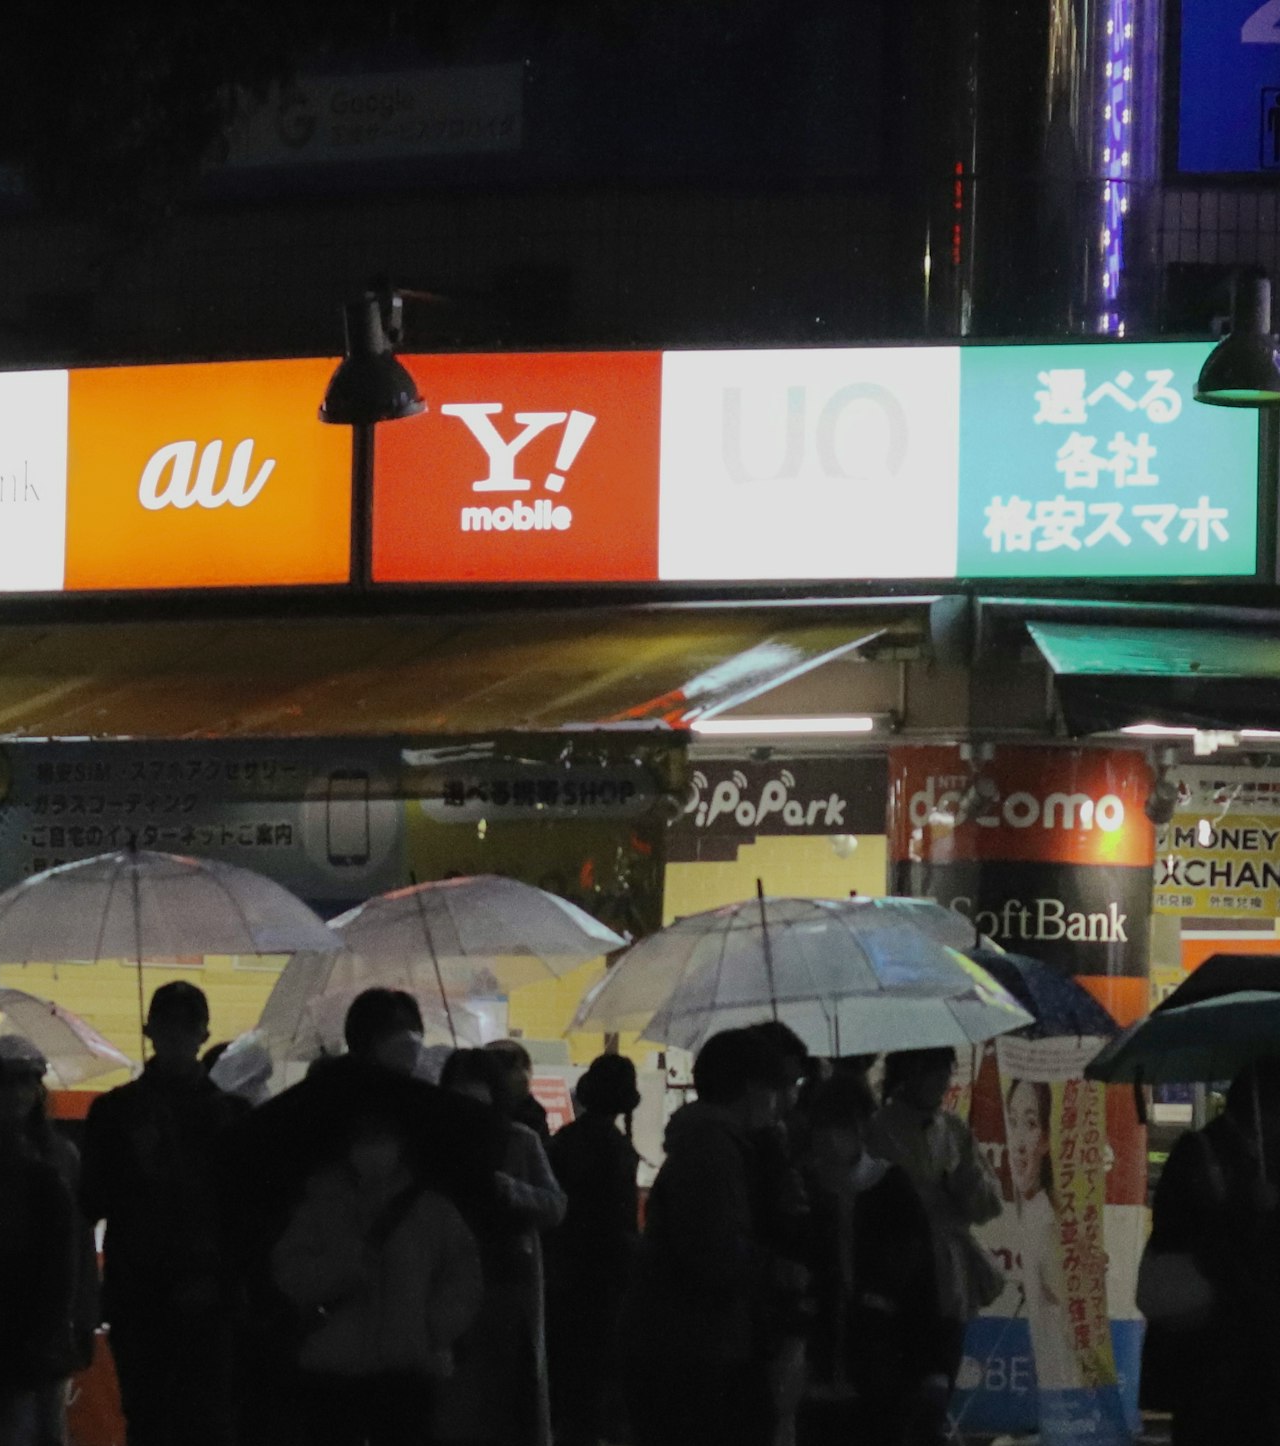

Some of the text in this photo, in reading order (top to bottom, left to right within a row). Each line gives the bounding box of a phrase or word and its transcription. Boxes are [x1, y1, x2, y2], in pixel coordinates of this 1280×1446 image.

[1033, 368, 1182, 425] 選べる
[138, 438, 276, 510] au
[441, 402, 597, 491] Y!
[1056, 431, 1159, 489] 各社
[461, 500, 572, 531] mobile
[983, 494, 1230, 553] 格安スマホ
[1175, 827, 1279, 850] MONEY
